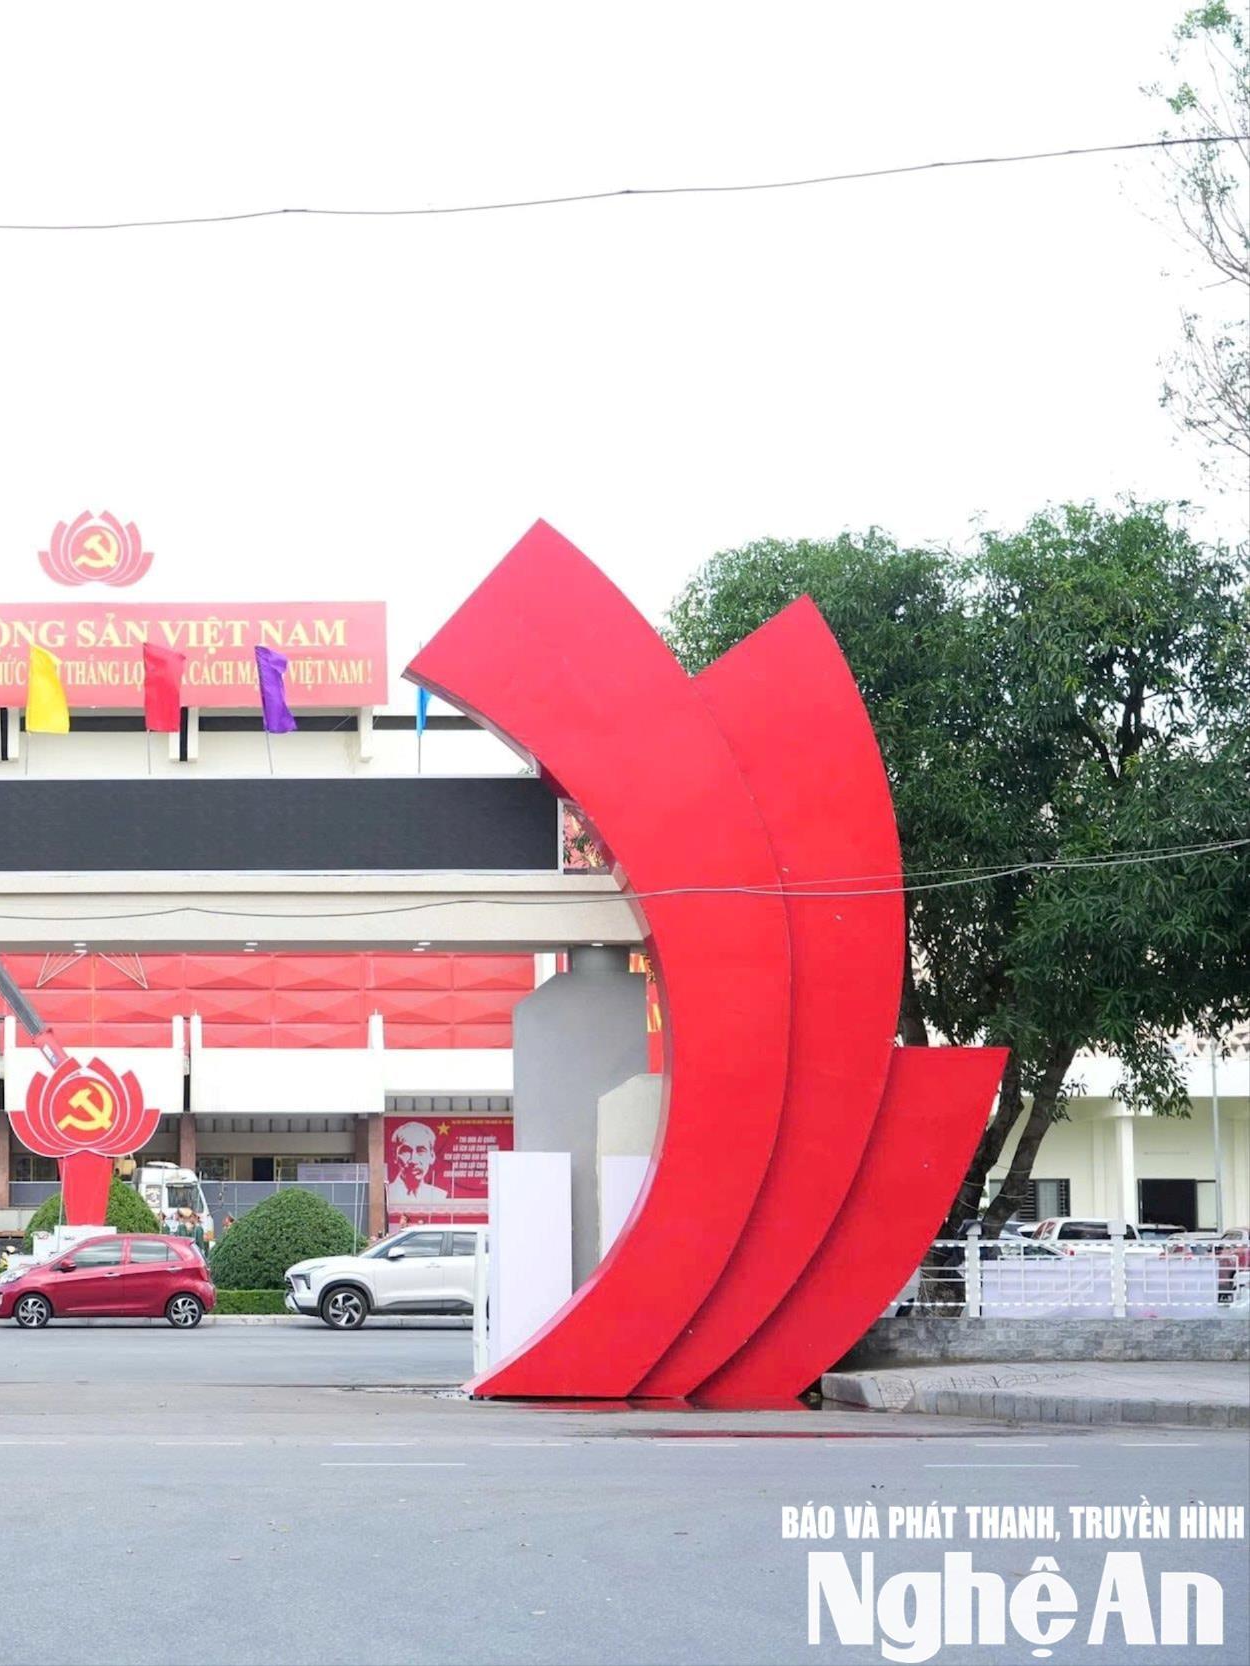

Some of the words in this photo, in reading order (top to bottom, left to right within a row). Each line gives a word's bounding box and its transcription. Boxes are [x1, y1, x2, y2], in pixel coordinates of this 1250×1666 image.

[76, 613, 149, 649] SẢN
[159, 616, 250, 655] VIỆT
[259, 619, 348, 648] NAM
[189, 655, 234, 686] CÁCH
[289, 656, 326, 691] VIỆT
[328, 660, 365, 685] NAM
